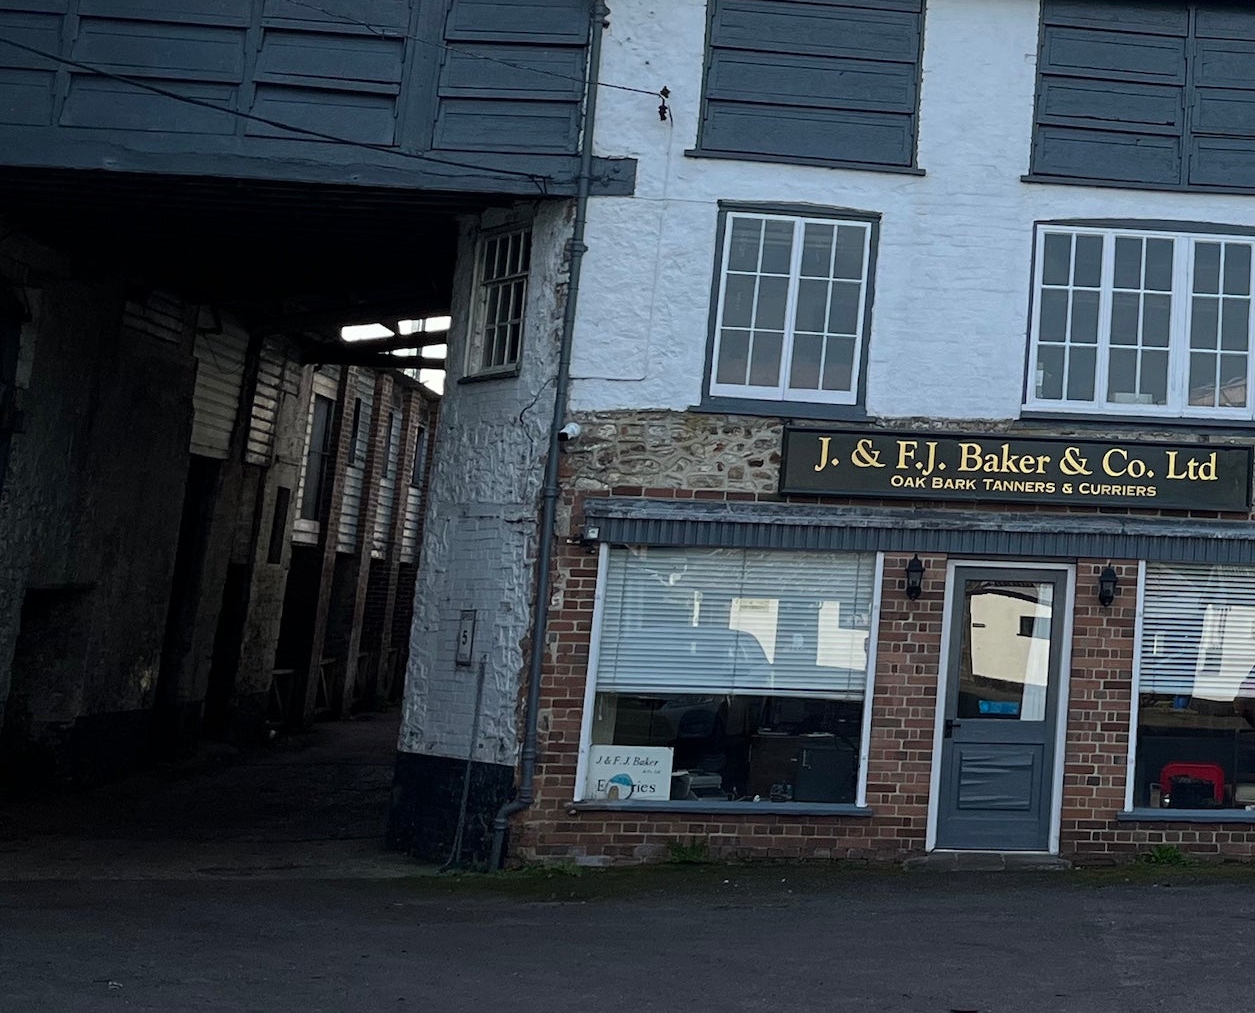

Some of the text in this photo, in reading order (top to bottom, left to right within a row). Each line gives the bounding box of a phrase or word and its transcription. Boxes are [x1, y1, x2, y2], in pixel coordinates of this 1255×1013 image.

[814, 436, 1219, 482] J. & F.J. Baker & Co. Ltd
[890, 474, 1157, 497] OAK BARK TANNERS & CURRIERS
[462, 630, 468, 645] 5
[604, 756, 612, 765] &
[633, 756, 659, 766] Baker
